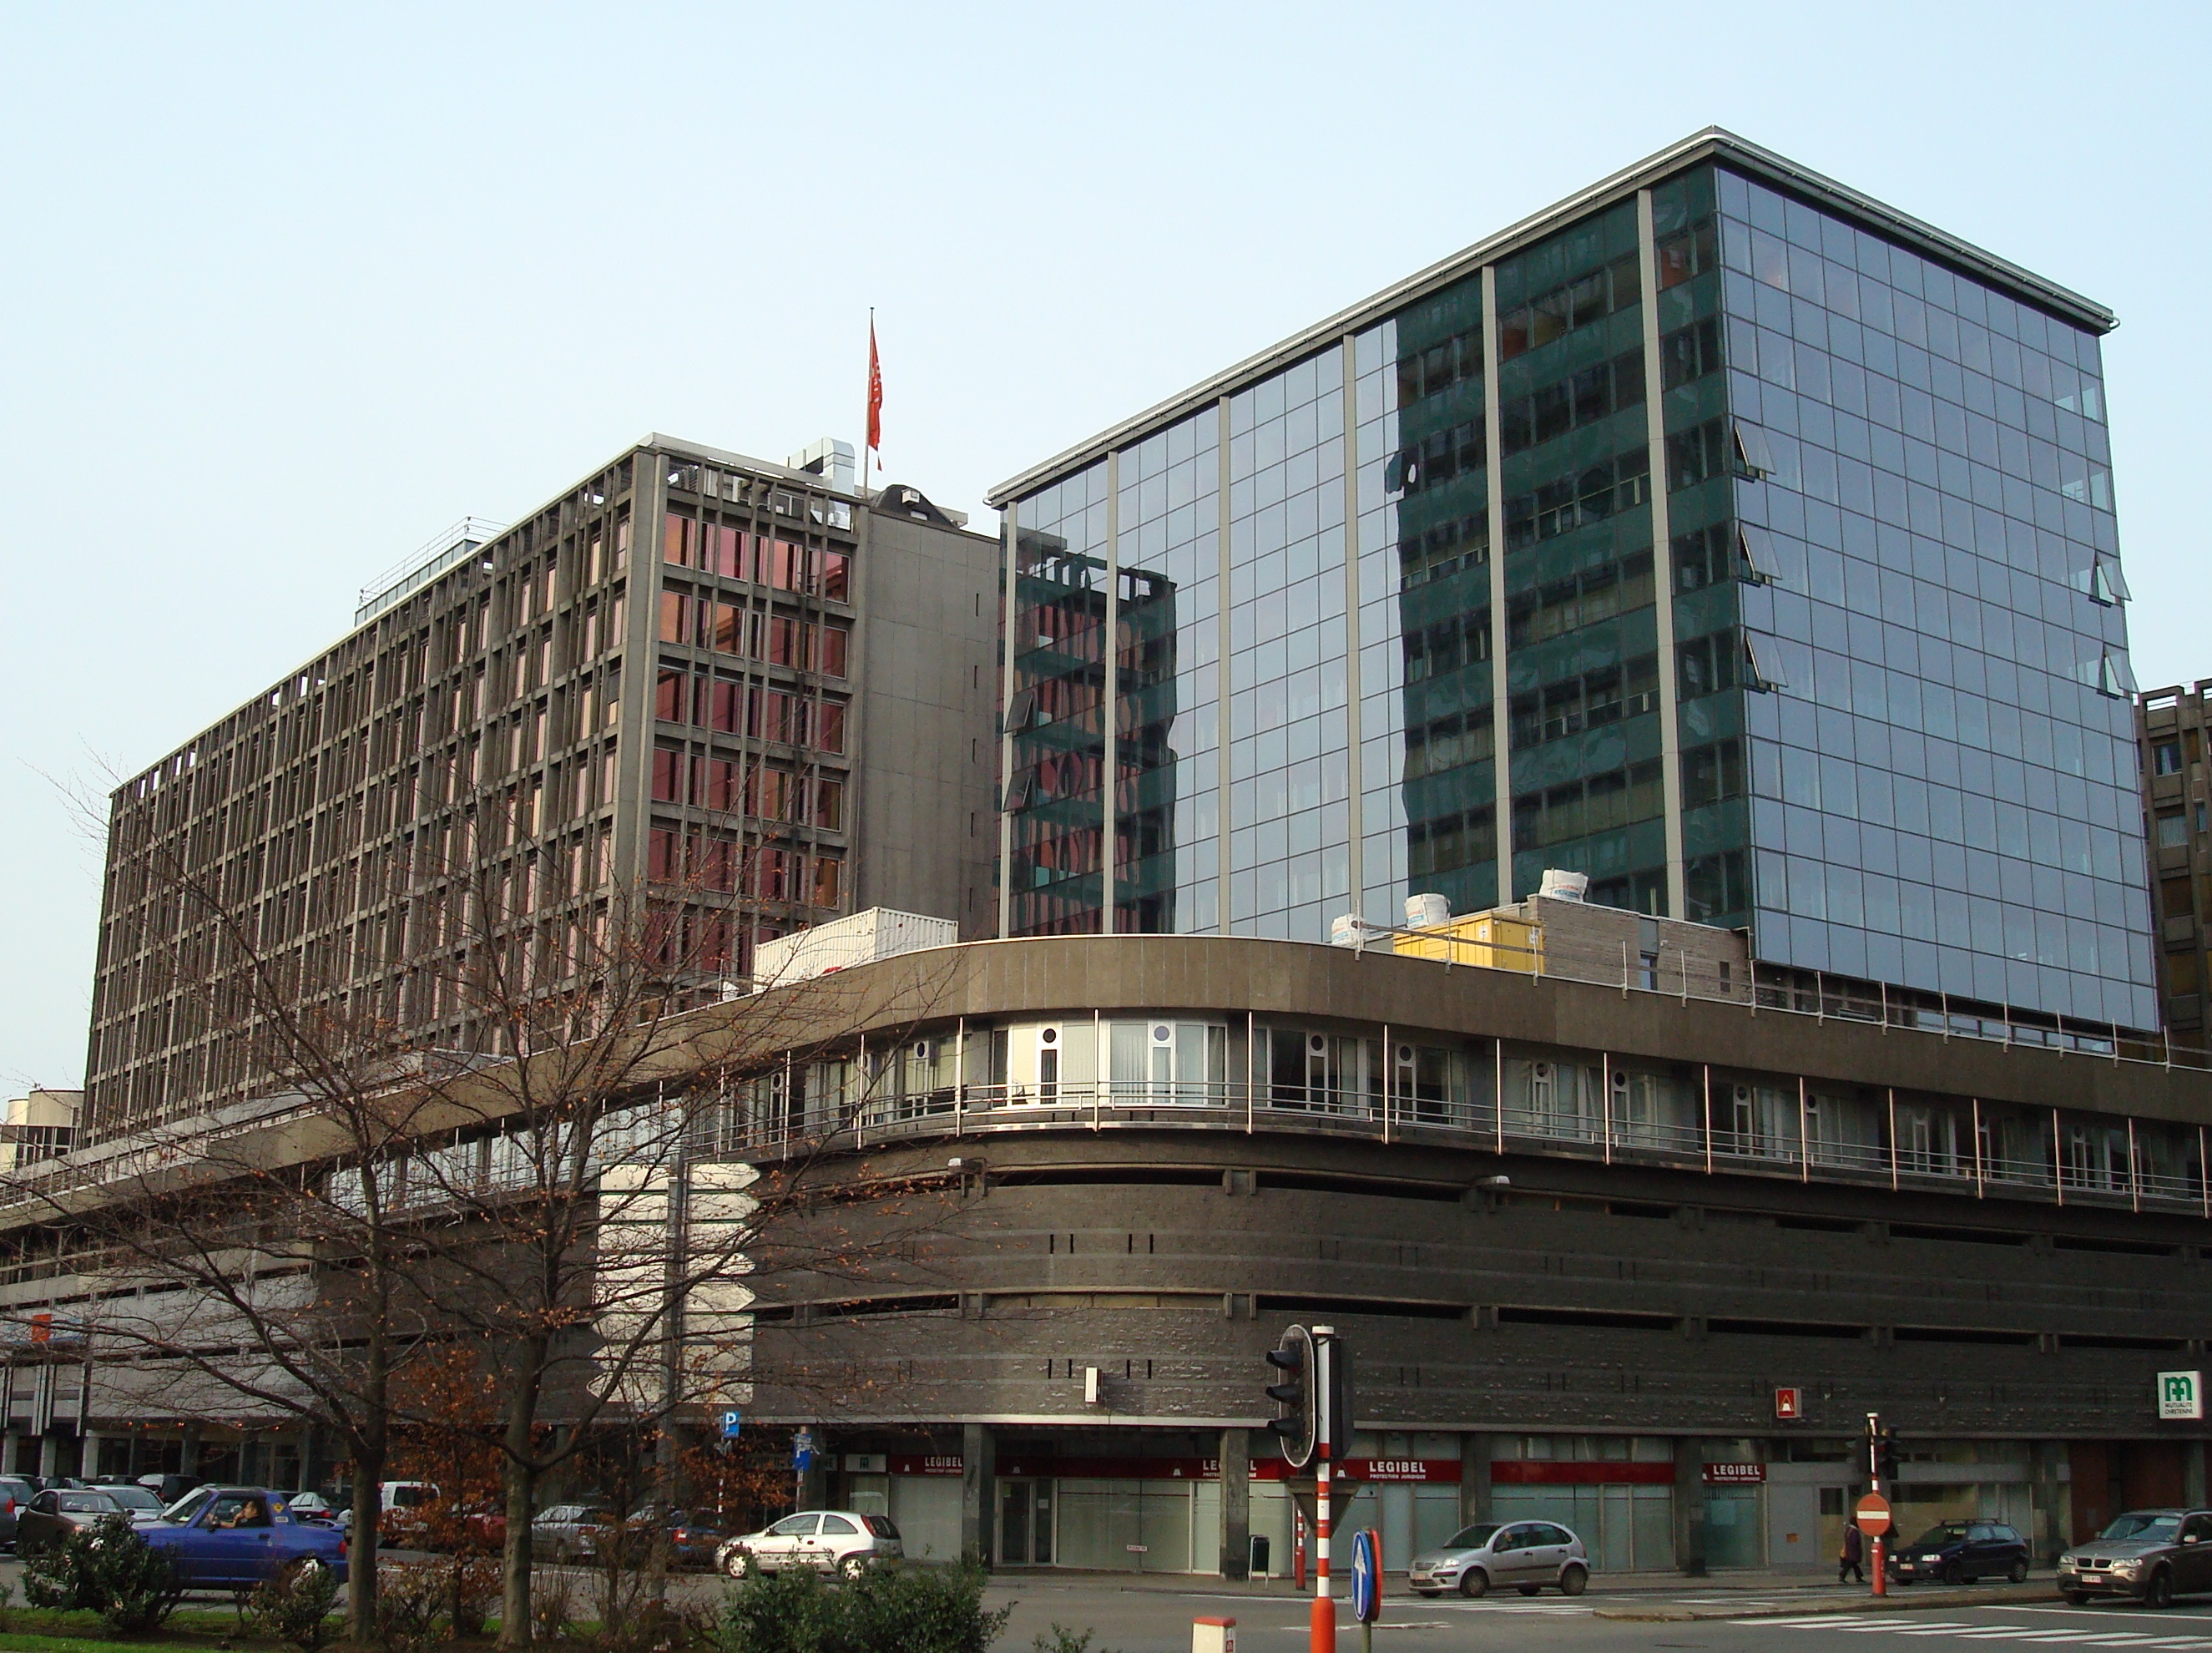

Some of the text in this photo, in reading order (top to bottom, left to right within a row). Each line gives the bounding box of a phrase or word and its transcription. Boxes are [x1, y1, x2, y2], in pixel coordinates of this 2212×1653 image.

[725, 1412, 736, 1431] P
[924, 1456, 963, 1468] LEGIBEL
[1369, 1461, 1427, 1473] LEGIBEL
[1713, 1464, 1760, 1475] LEGIBEL
